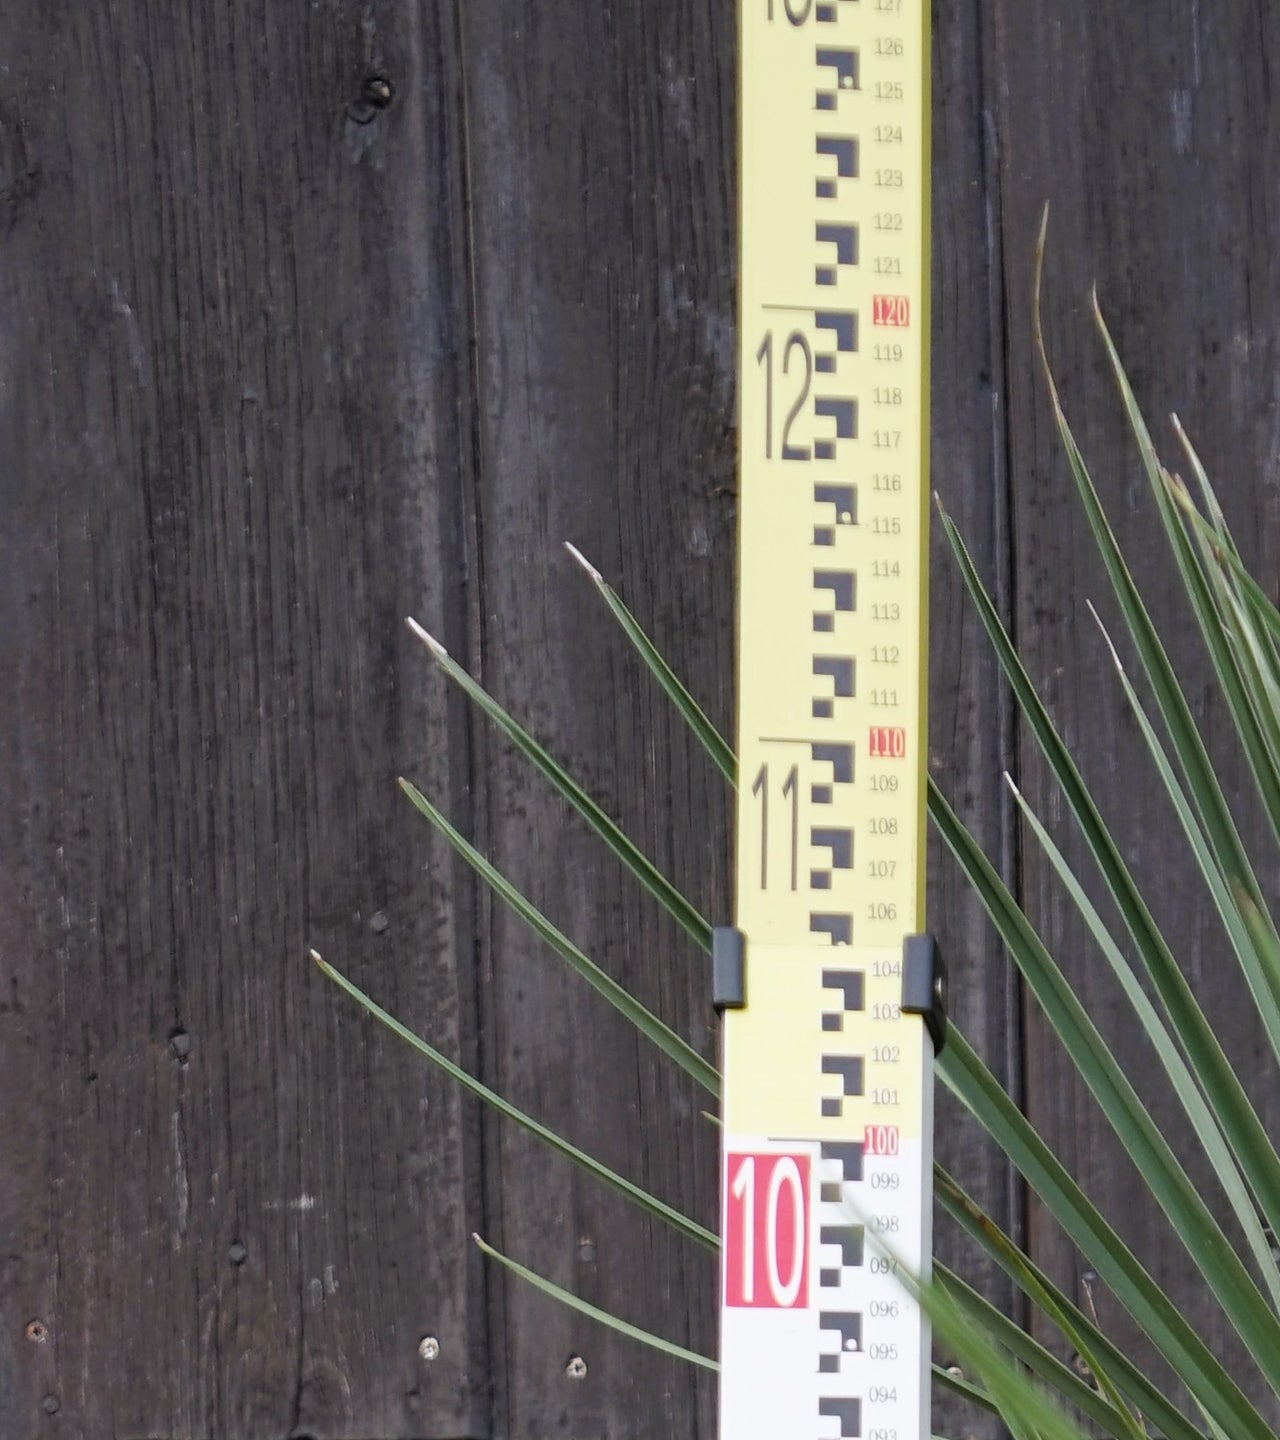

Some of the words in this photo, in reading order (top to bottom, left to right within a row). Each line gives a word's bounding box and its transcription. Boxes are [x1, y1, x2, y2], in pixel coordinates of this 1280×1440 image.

[874, 37, 904, 57] 126
[874, 80, 904, 101] 125
[873, 124, 903, 145] 124
[873, 168, 904, 189] 123
[873, 212, 903, 233] 122
[873, 256, 902, 276] 121
[874, 298, 909, 325] 120
[873, 343, 903, 363] 119
[757, 328, 812, 461] 12
[872, 386, 903, 406] 118
[872, 430, 902, 449] 117
[872, 473, 902, 492] 116
[872, 516, 902, 536] 115
[871, 559, 901, 578] 114
[871, 602, 901, 621] 113
[870, 645, 900, 666] 112
[870, 688, 899, 707] 111
[870, 728, 905, 756] 110
[869, 774, 899, 793] 109
[752, 762, 798, 891] 11
[869, 817, 899, 835] 108
[868, 859, 897, 879] 107
[867, 902, 898, 921] 106
[871, 960, 901, 978] 104
[871, 1003, 901, 1021] 103
[872, 1045, 901, 1066] 102
[871, 1088, 899, 1106] 101
[865, 1128, 898, 1153] 100
[870, 1172, 900, 1190] 099
[733, 1156, 805, 1306] 10
[869, 1300, 899, 1318] 096
[869, 1343, 899, 1361] 095
[868, 1386, 898, 1404] 094
